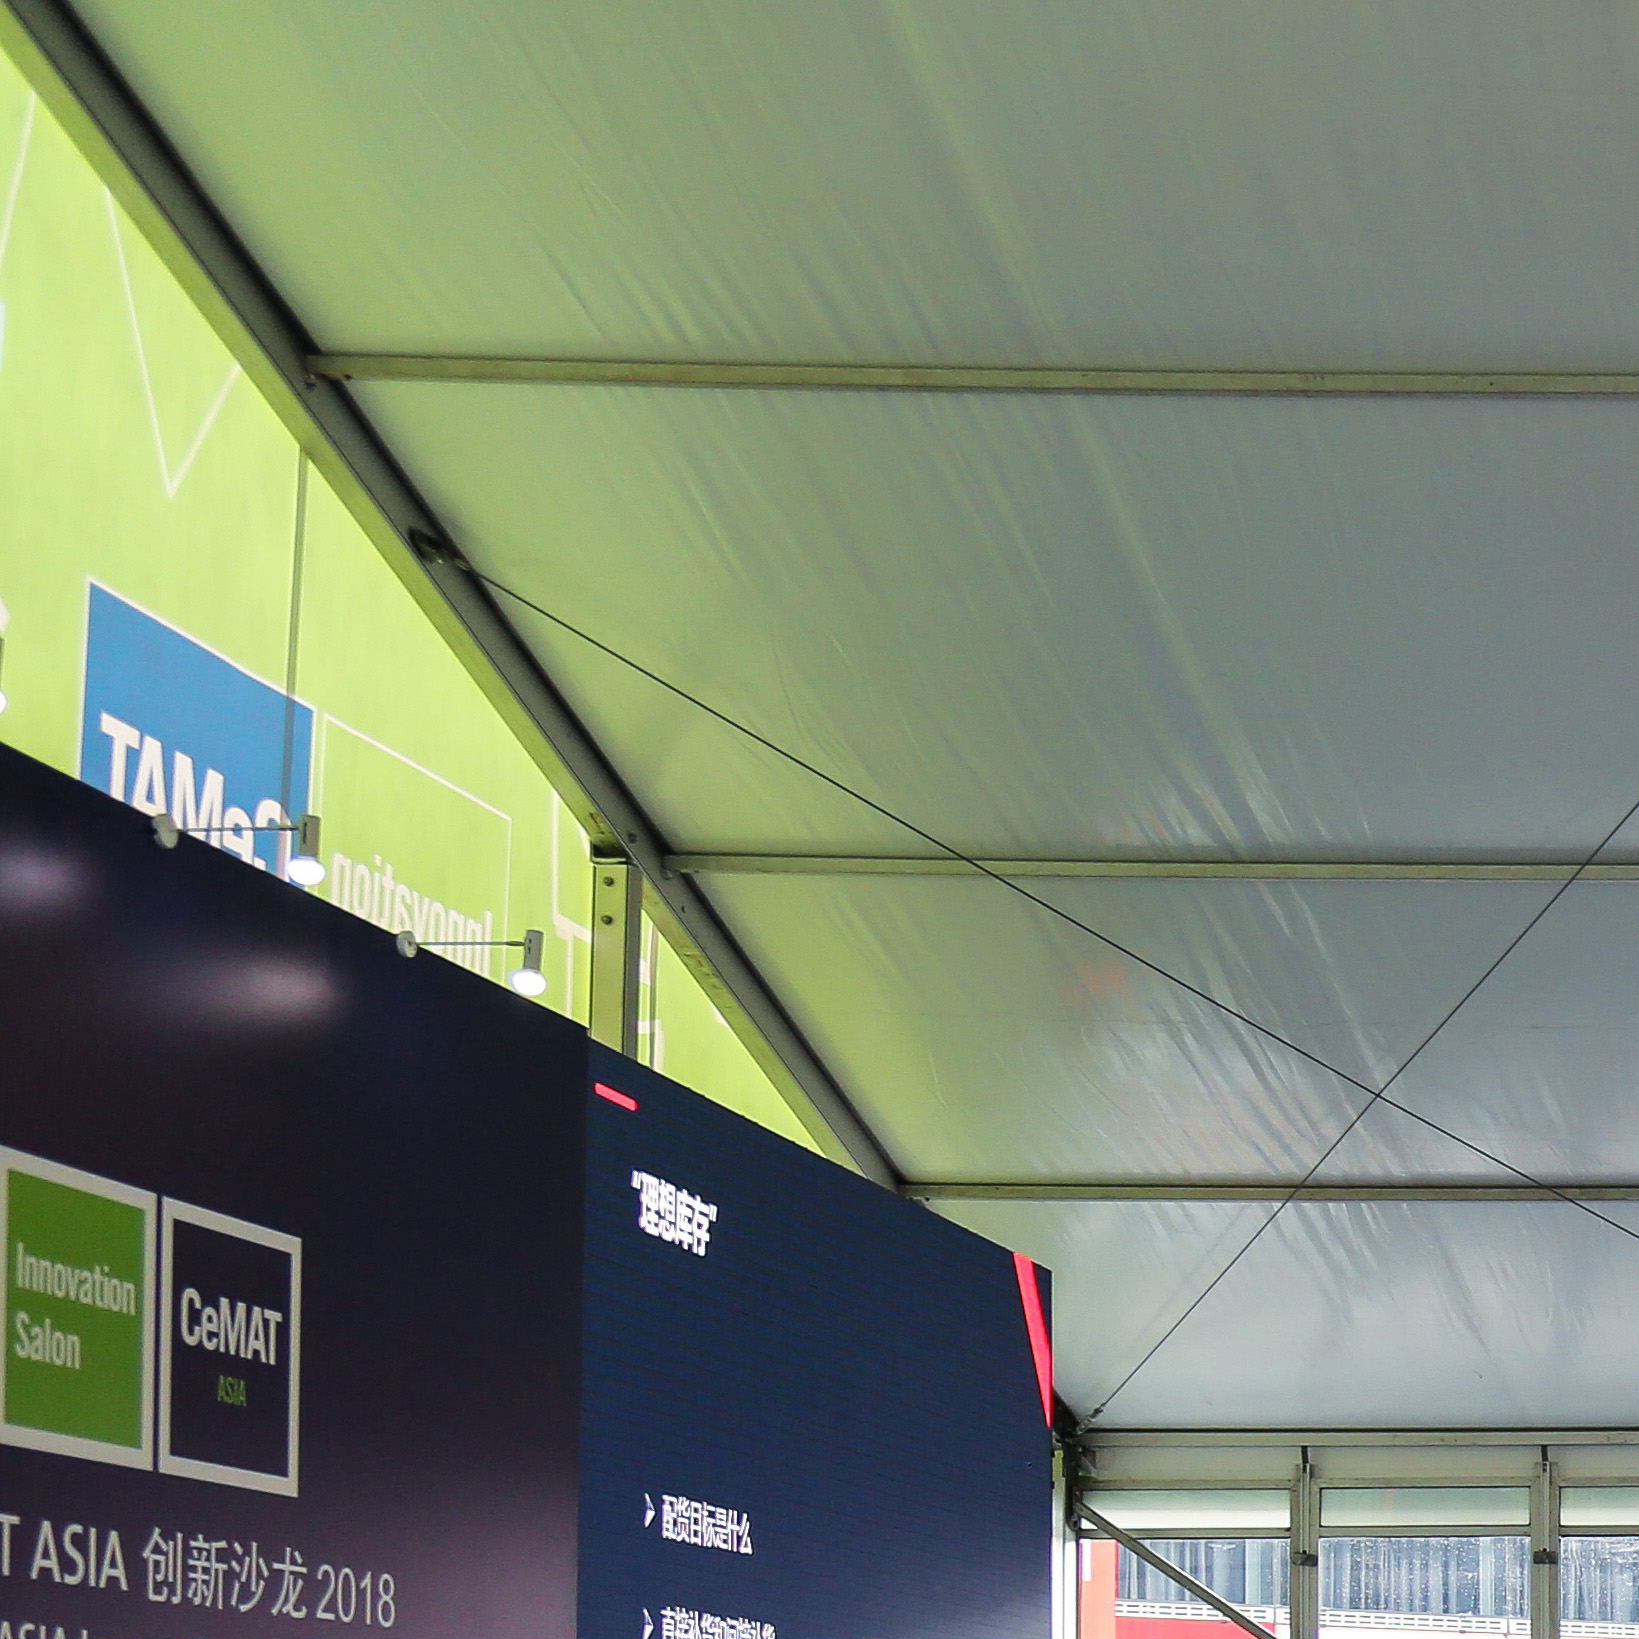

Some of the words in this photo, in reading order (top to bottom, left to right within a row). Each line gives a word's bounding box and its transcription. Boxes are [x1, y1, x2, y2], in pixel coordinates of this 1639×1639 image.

[16, 1242, 137, 1316] Innovation
[15, 1312, 81, 1370] Salon
[180, 1287, 283, 1366] CeMAT
[217, 1375, 248, 1408] ASIA
[662, 1494, 753, 1555] 配货目标是什么
[30, 1520, 129, 1592] ASIA
[142, 1526, 309, 1621] 创新沙龙
[316, 1563, 397, 1629] 2018
